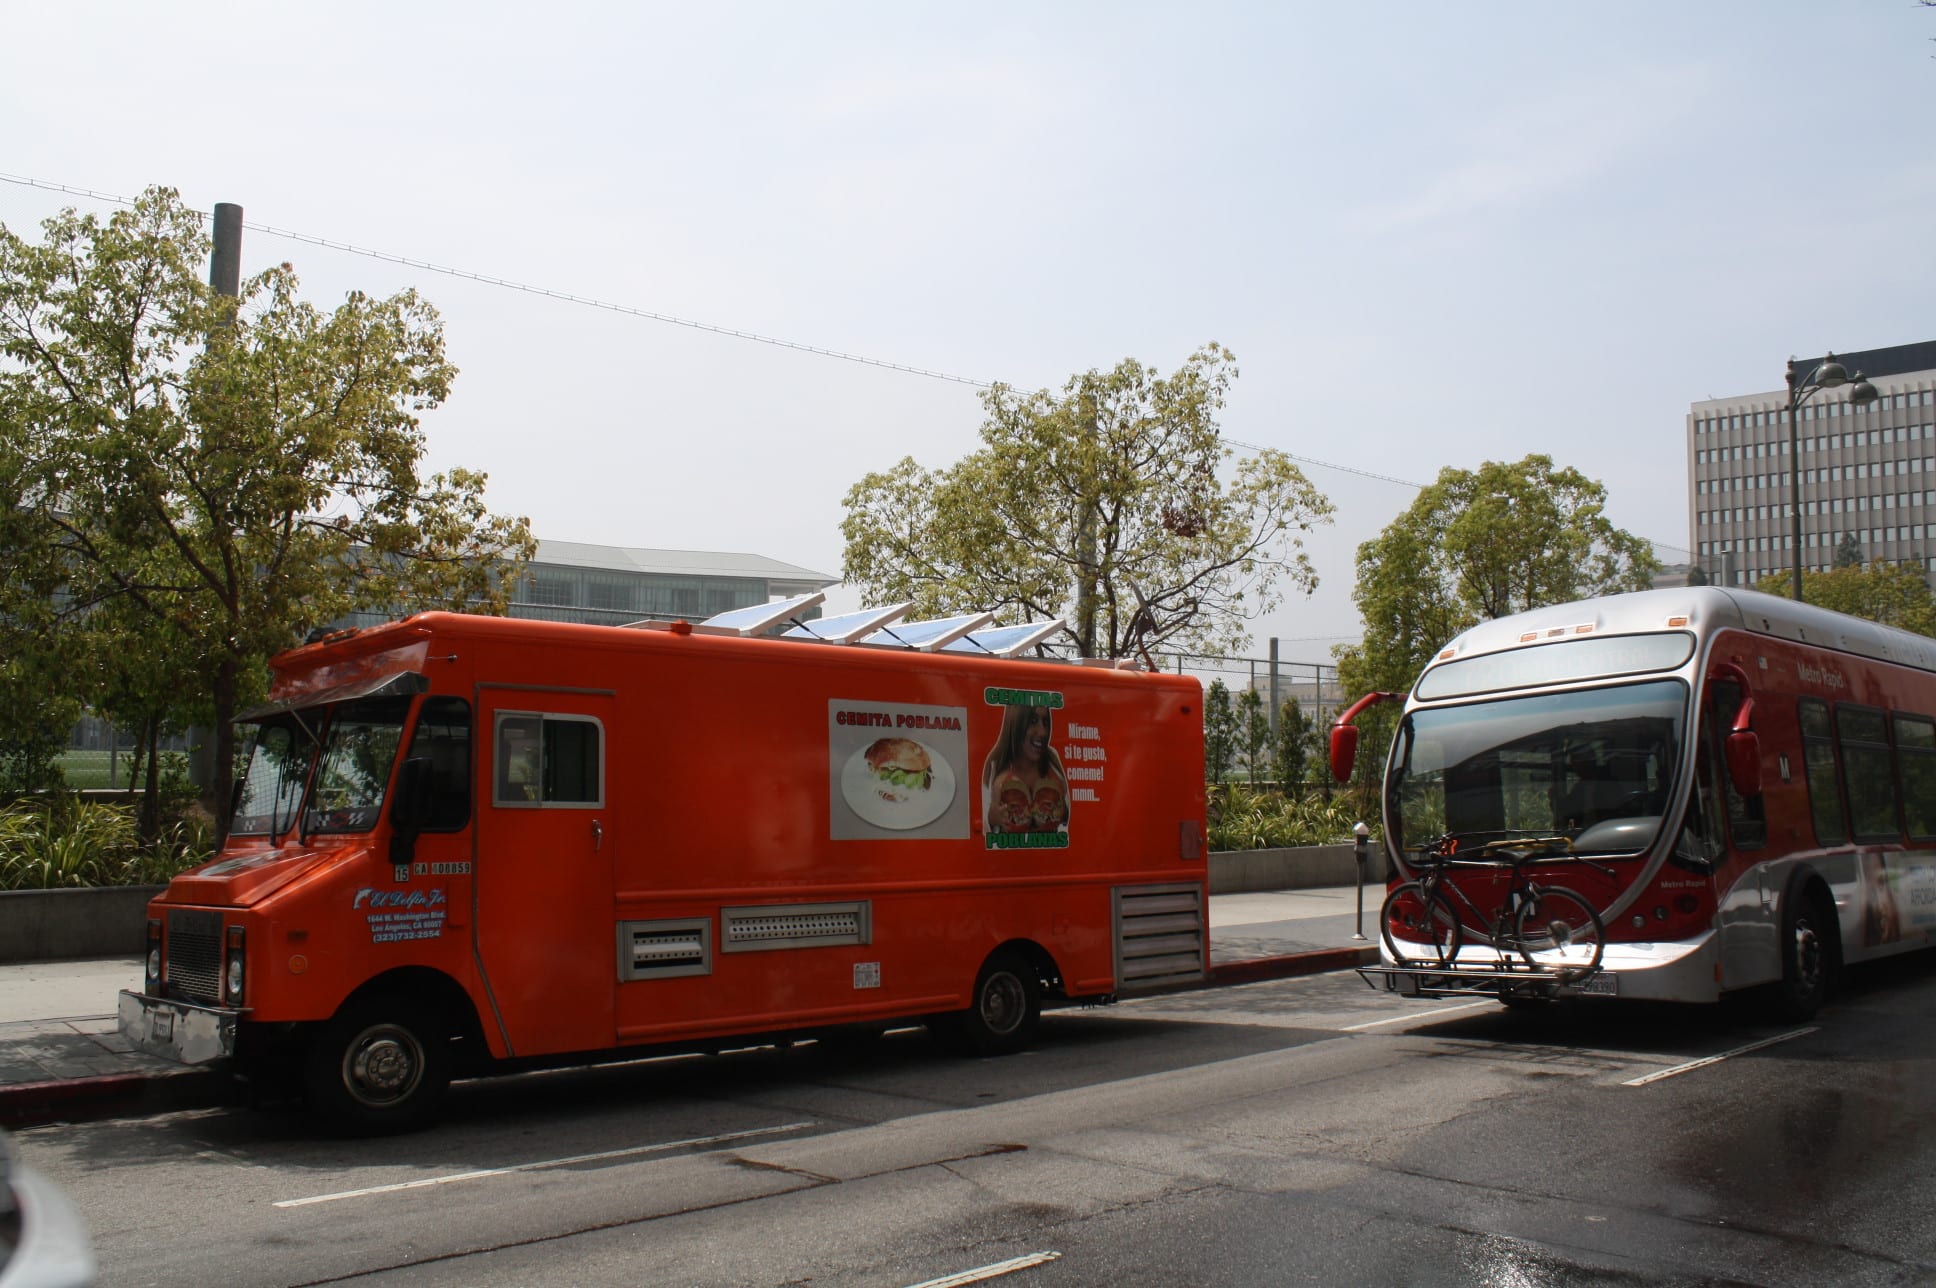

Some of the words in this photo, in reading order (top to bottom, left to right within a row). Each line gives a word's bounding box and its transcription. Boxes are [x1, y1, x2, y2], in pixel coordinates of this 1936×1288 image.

[985, 687, 1064, 708] CEMITAS
[836, 711, 892, 727] CEMITA
[896, 714, 962, 731] POBLANA
[1073, 745, 1082, 760] te
[1082, 746, 1107, 762] gusto,
[986, 832, 1068, 848] POBLANAS
[397, 869, 408, 880] 15
[414, 863, 427, 874] CA
[413, 920, 422, 928] CA
